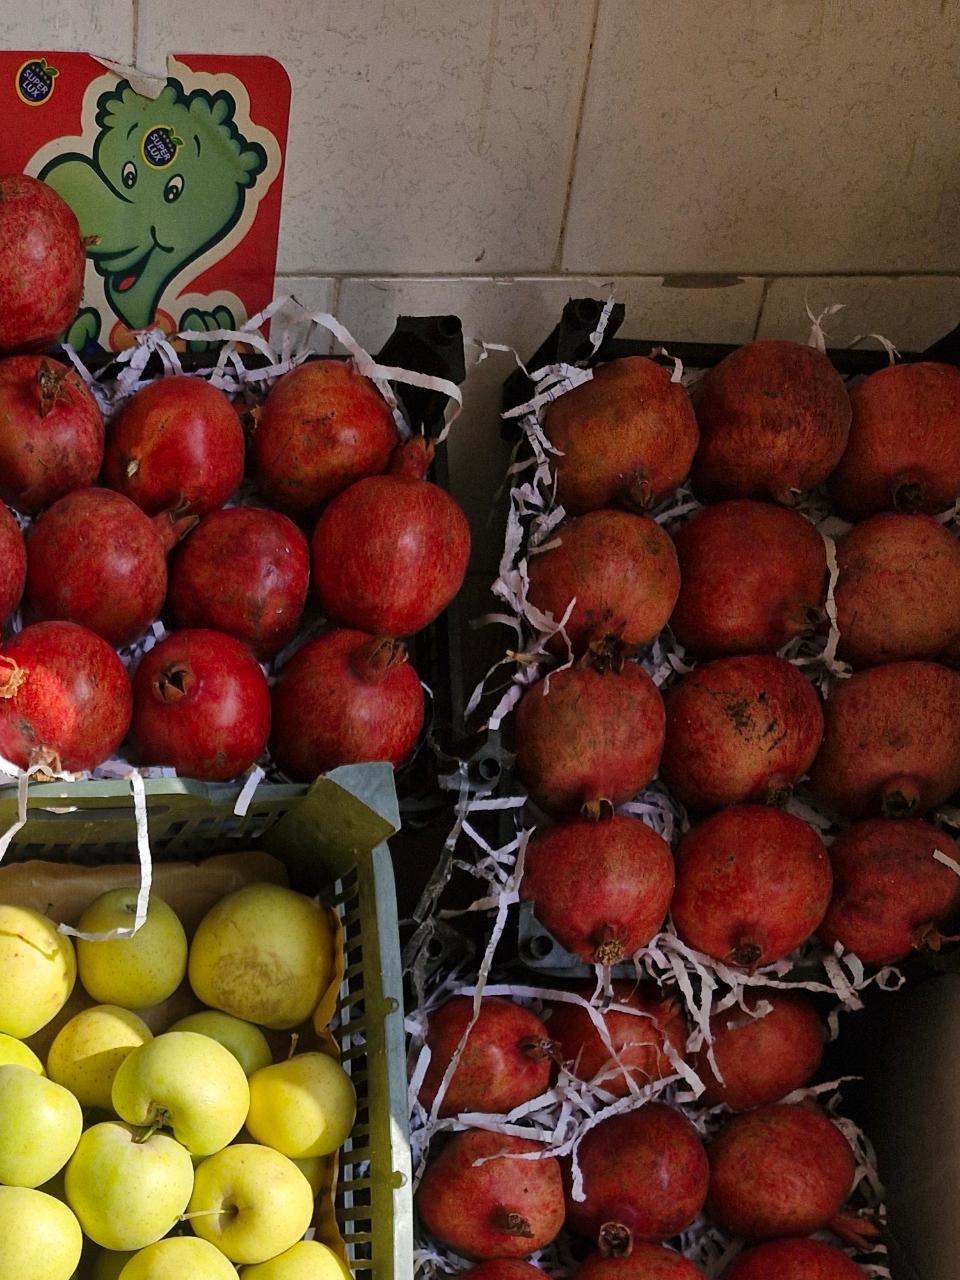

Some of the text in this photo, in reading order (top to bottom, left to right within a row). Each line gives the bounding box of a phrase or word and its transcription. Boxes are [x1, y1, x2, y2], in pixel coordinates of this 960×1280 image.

[22, 80, 40, 97] LUX
[24, 69, 48, 95] SUPER
[147, 144, 162, 162] LUX
[150, 133, 171, 161] SUPER
